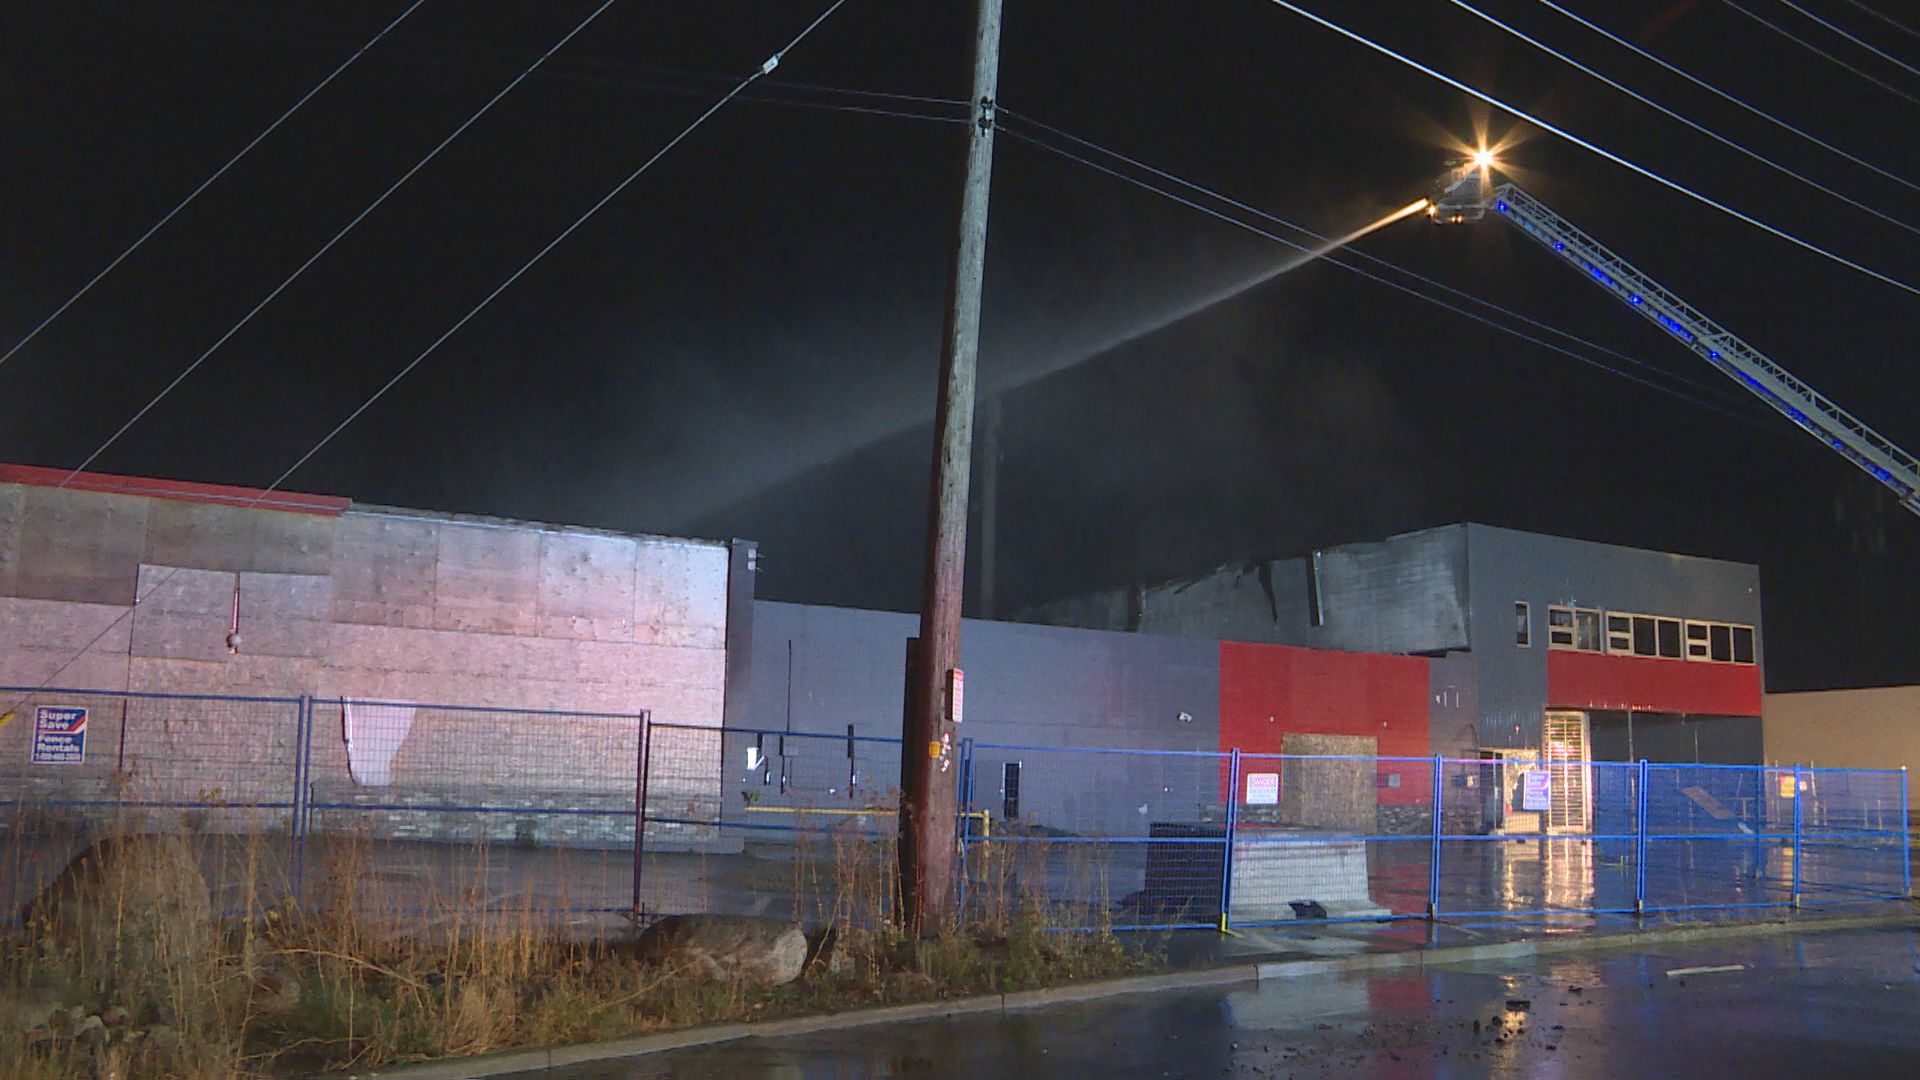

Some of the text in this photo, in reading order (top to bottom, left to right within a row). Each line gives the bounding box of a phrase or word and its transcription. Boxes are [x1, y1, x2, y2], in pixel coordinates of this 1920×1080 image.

[40, 709, 77, 722] Super
[40, 719, 69, 730] Save
[39, 734, 72, 743] Fence
[37, 743, 80, 752] Rentals
